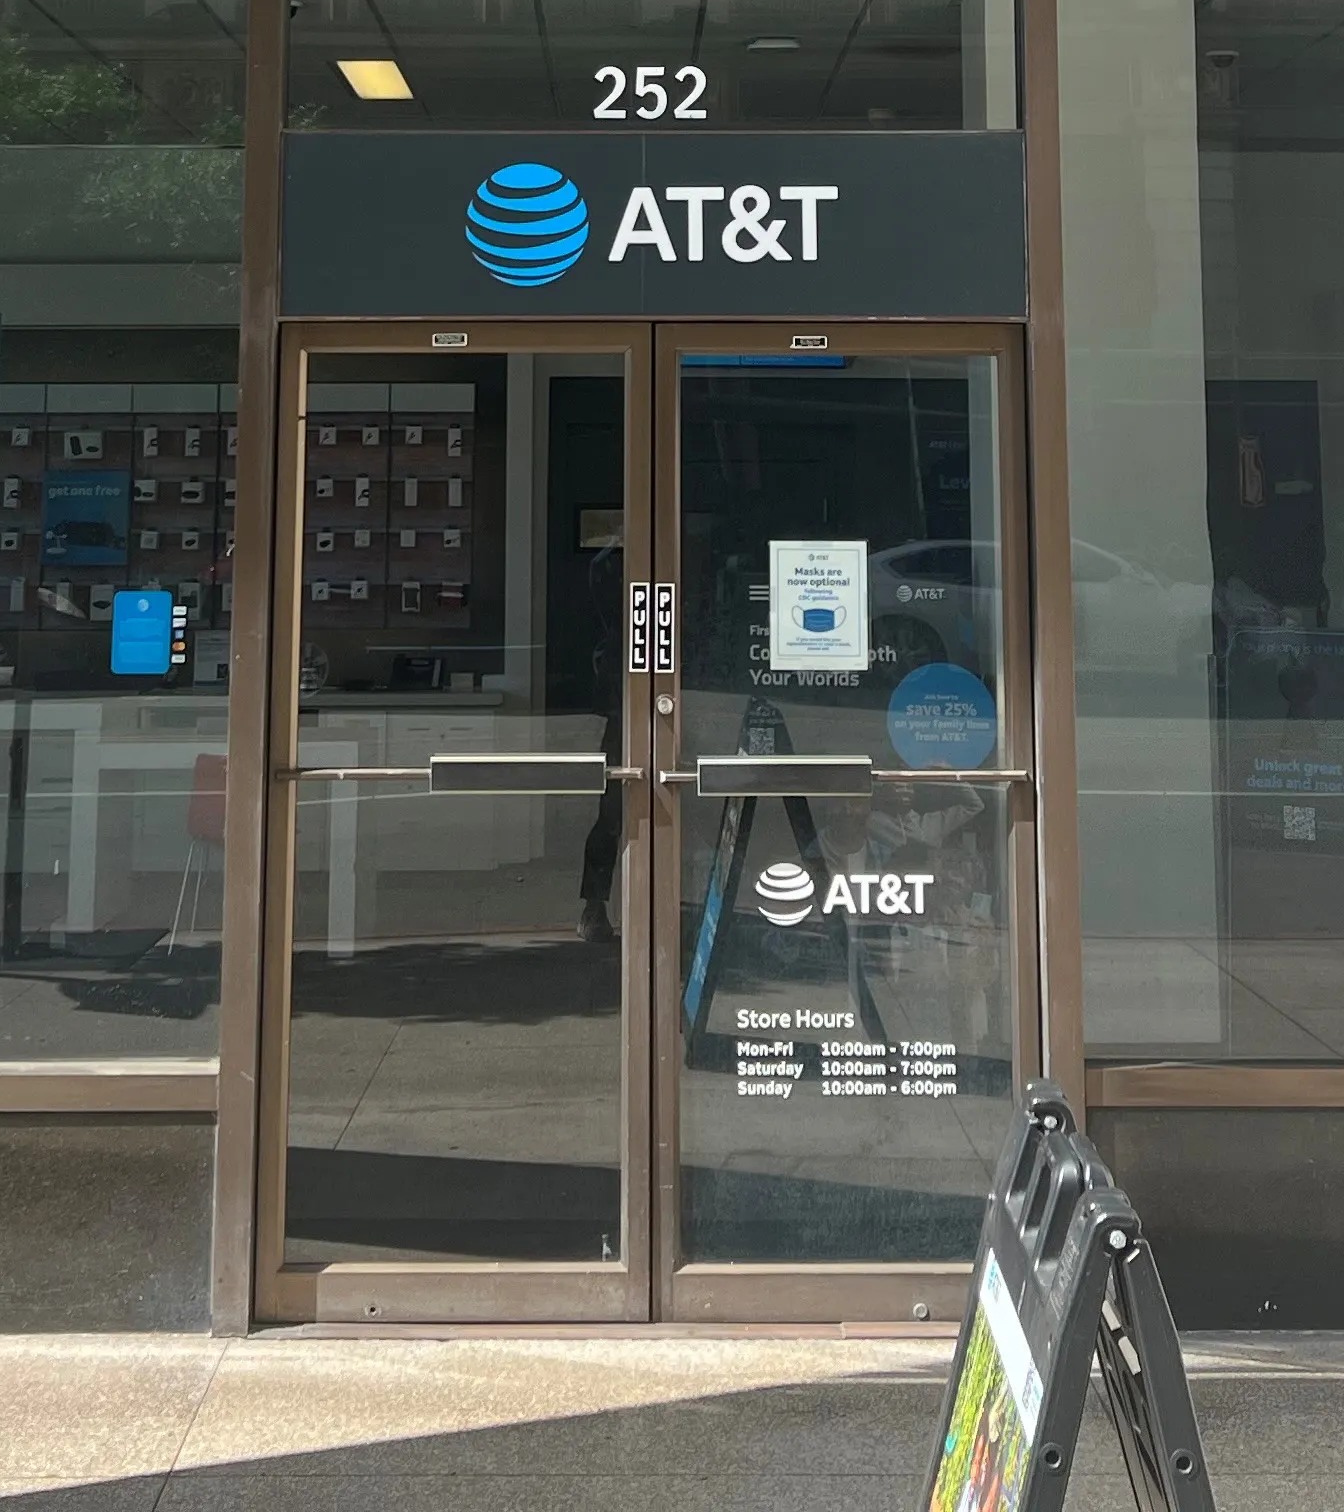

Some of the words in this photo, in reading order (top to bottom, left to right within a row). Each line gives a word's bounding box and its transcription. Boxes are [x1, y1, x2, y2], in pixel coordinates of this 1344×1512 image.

[593, 65, 708, 120] 252
[608, 184, 839, 263] AT&T
[794, 567, 825, 577] Masks
[787, 578, 807, 586] now
[809, 576, 850, 588] optional
[914, 588, 945, 600] AT&T
[633, 590, 646, 664] PULL
[659, 591, 671, 665] PULL
[749, 669, 791, 686] Your
[797, 670, 859, 686] Worlds
[906, 703, 941, 716] save
[944, 702, 978, 717] 25%
[1254, 757, 1301, 772] Unlock
[1286, 776, 1312, 790] and
[822, 873, 934, 915] AT&T
[737, 1009, 791, 1029] Store
[796, 1009, 855, 1029] Hours
[737, 1041, 794, 1057] Mon-Fri
[821, 1041, 887, 1056] 10:00am
[900, 1041, 957, 1059] 7:00pm
[737, 1061, 804, 1079] Saturday
[821, 1061, 887, 1076] 10:00am
[900, 1061, 957, 1079] 7:00pm
[737, 1081, 793, 1099] Sunday
[821, 1081, 887, 1096] 10:00am
[900, 1081, 957, 1099] 6:00pm
